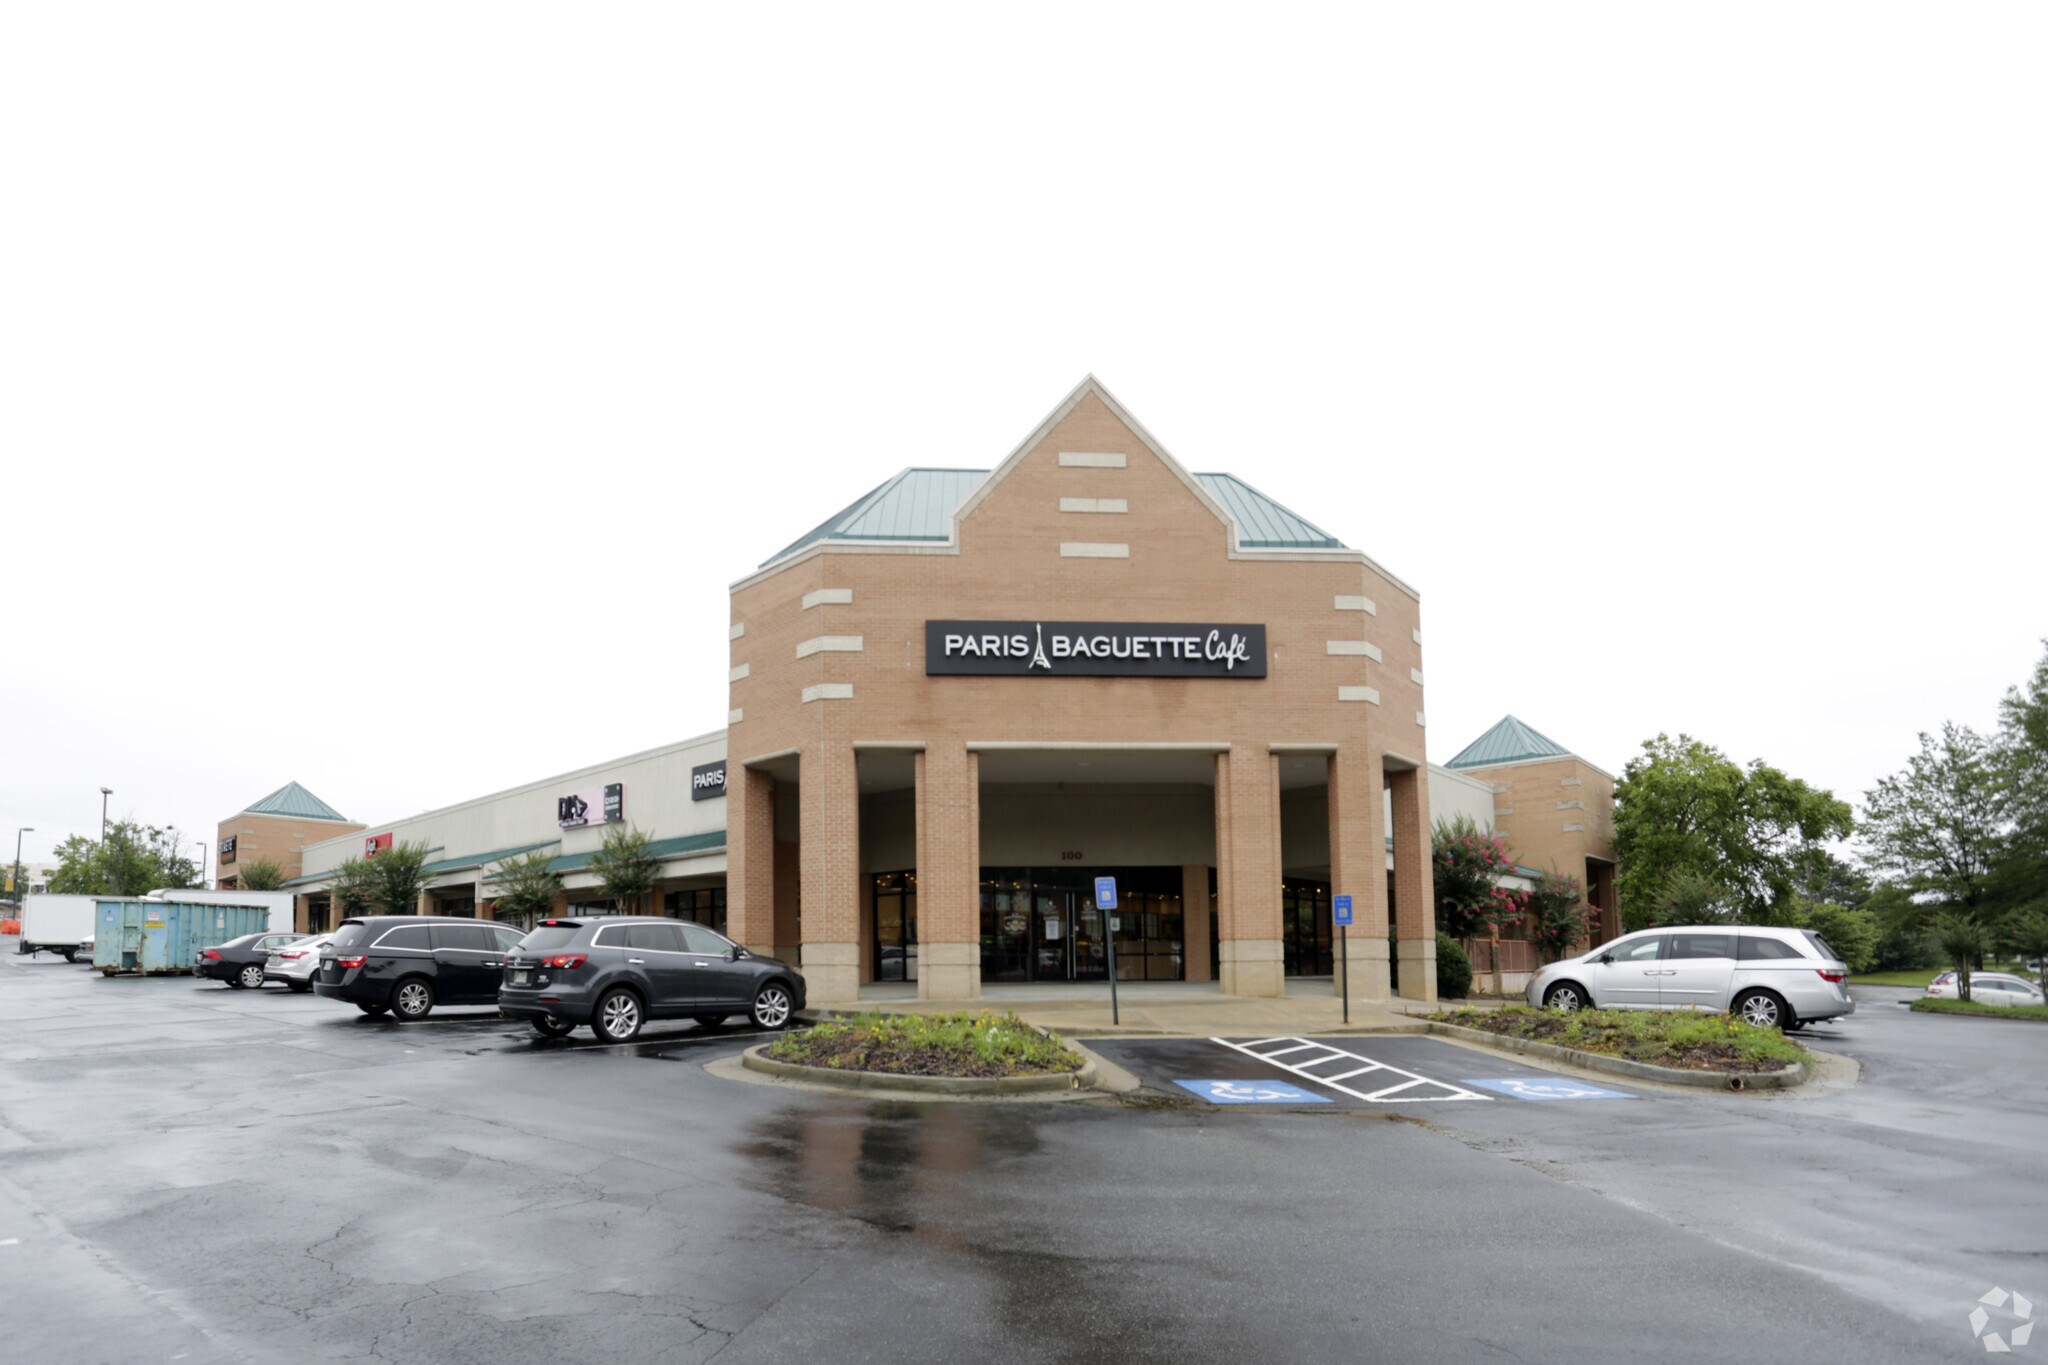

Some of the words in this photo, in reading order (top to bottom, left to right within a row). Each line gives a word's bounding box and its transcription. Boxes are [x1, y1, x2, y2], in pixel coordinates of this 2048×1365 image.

[945, 634, 1029, 657] PARIS
[1052, 635, 1202, 658] BAGUETTE
[1205, 629, 1250, 670] Café
[693, 769, 725, 790] PARIS
[1061, 851, 1082, 860] 100
